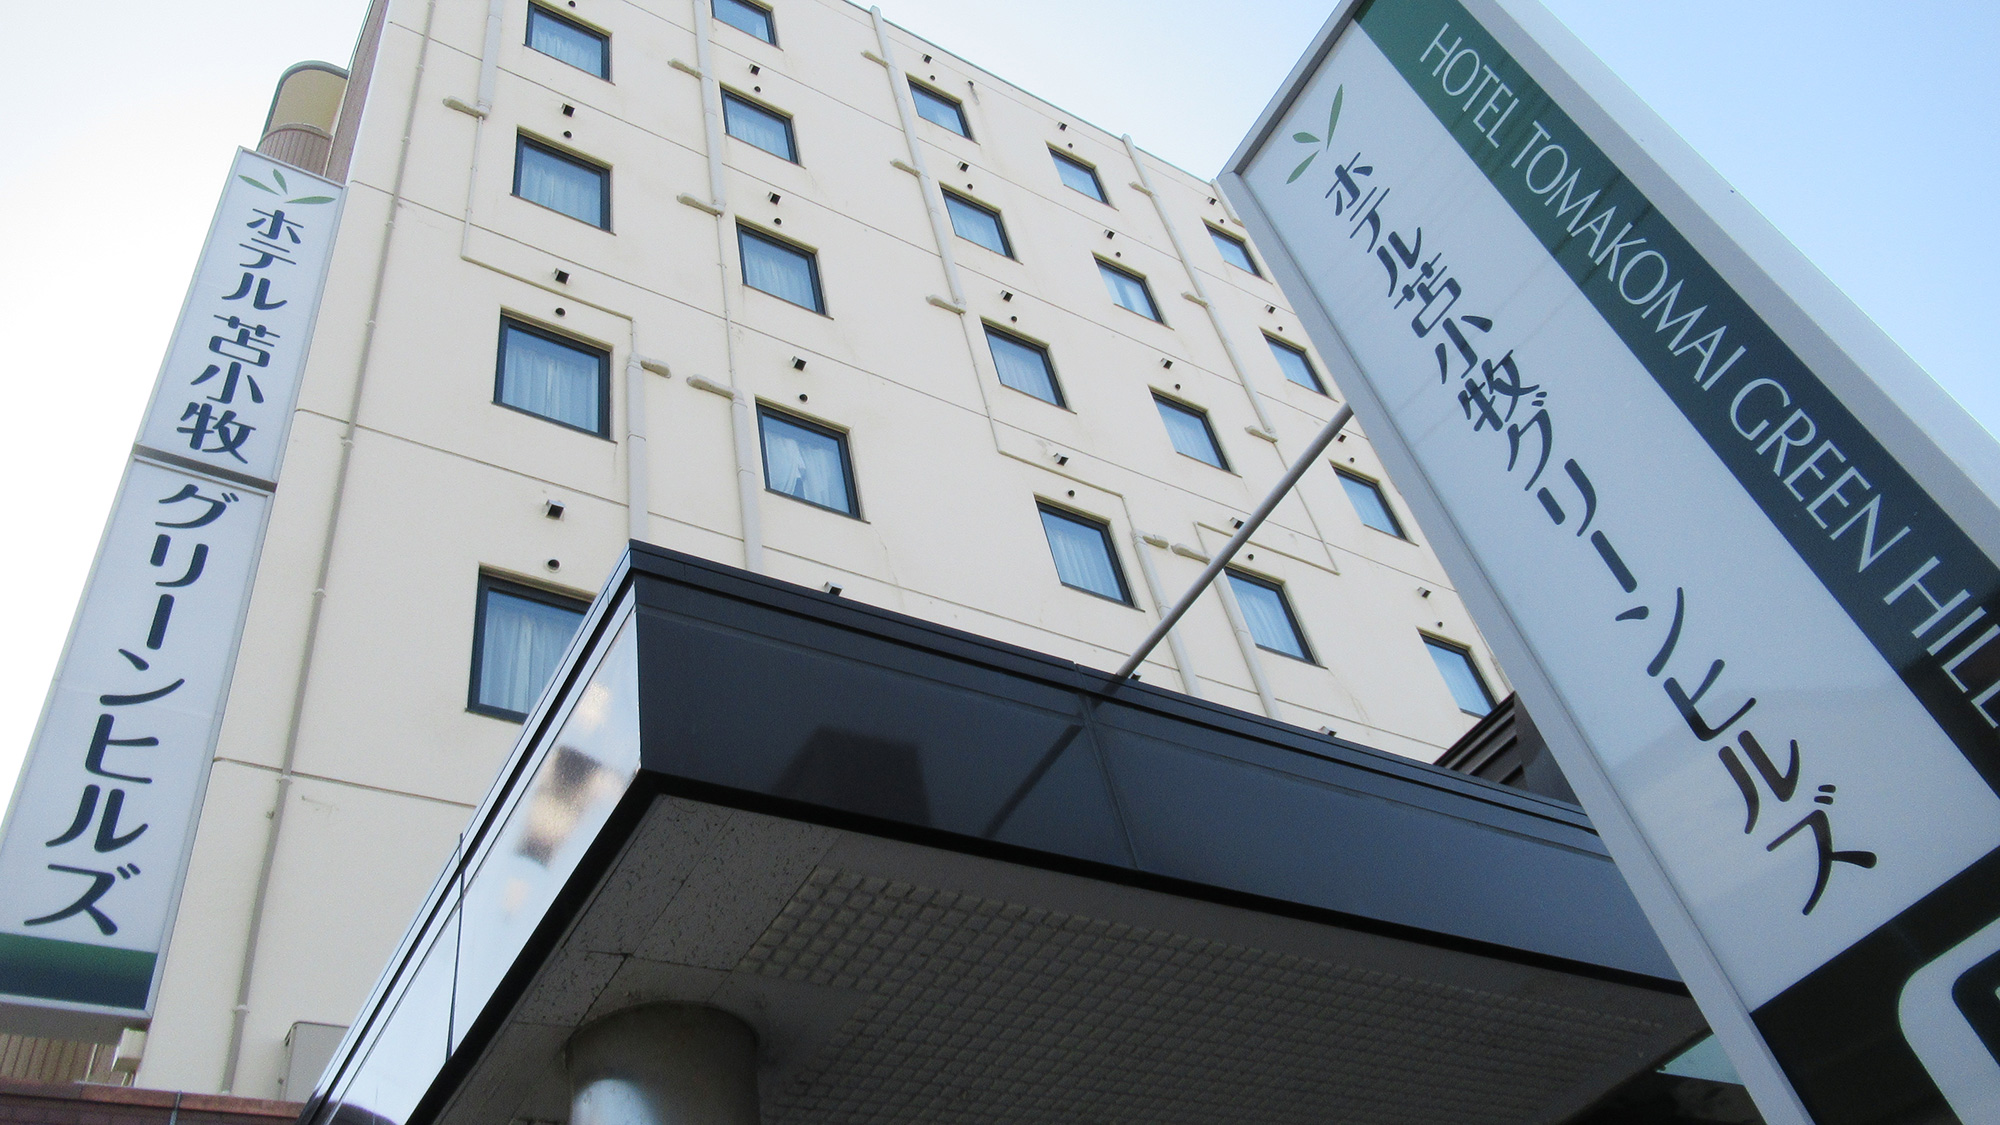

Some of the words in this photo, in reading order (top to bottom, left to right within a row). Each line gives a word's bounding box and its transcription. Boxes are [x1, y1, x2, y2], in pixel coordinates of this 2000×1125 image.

[1420, 23, 1520, 149] HOTEL
[1511, 121, 1746, 391] TOMAKOMAI
[1730, 378, 1911, 573] GREEN
